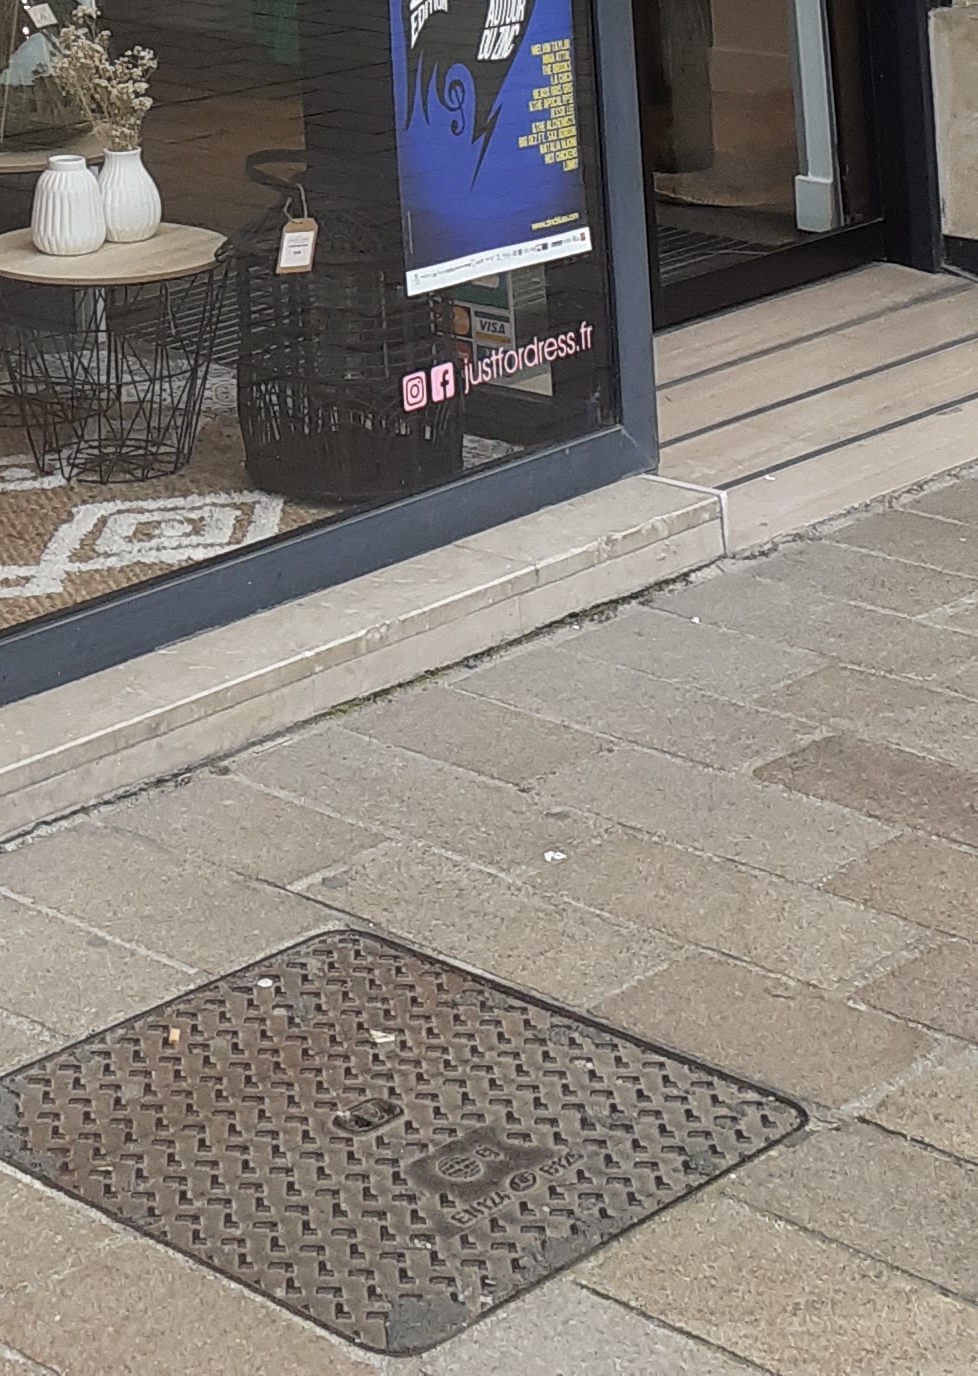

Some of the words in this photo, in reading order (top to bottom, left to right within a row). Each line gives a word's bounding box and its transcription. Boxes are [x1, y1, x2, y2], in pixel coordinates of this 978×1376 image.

[477, 27, 499, 60] DU
[491, 23, 521, 60] ZINC
[479, 319, 506, 335] VISA
[463, 320, 594, 395] justfordress.fr
